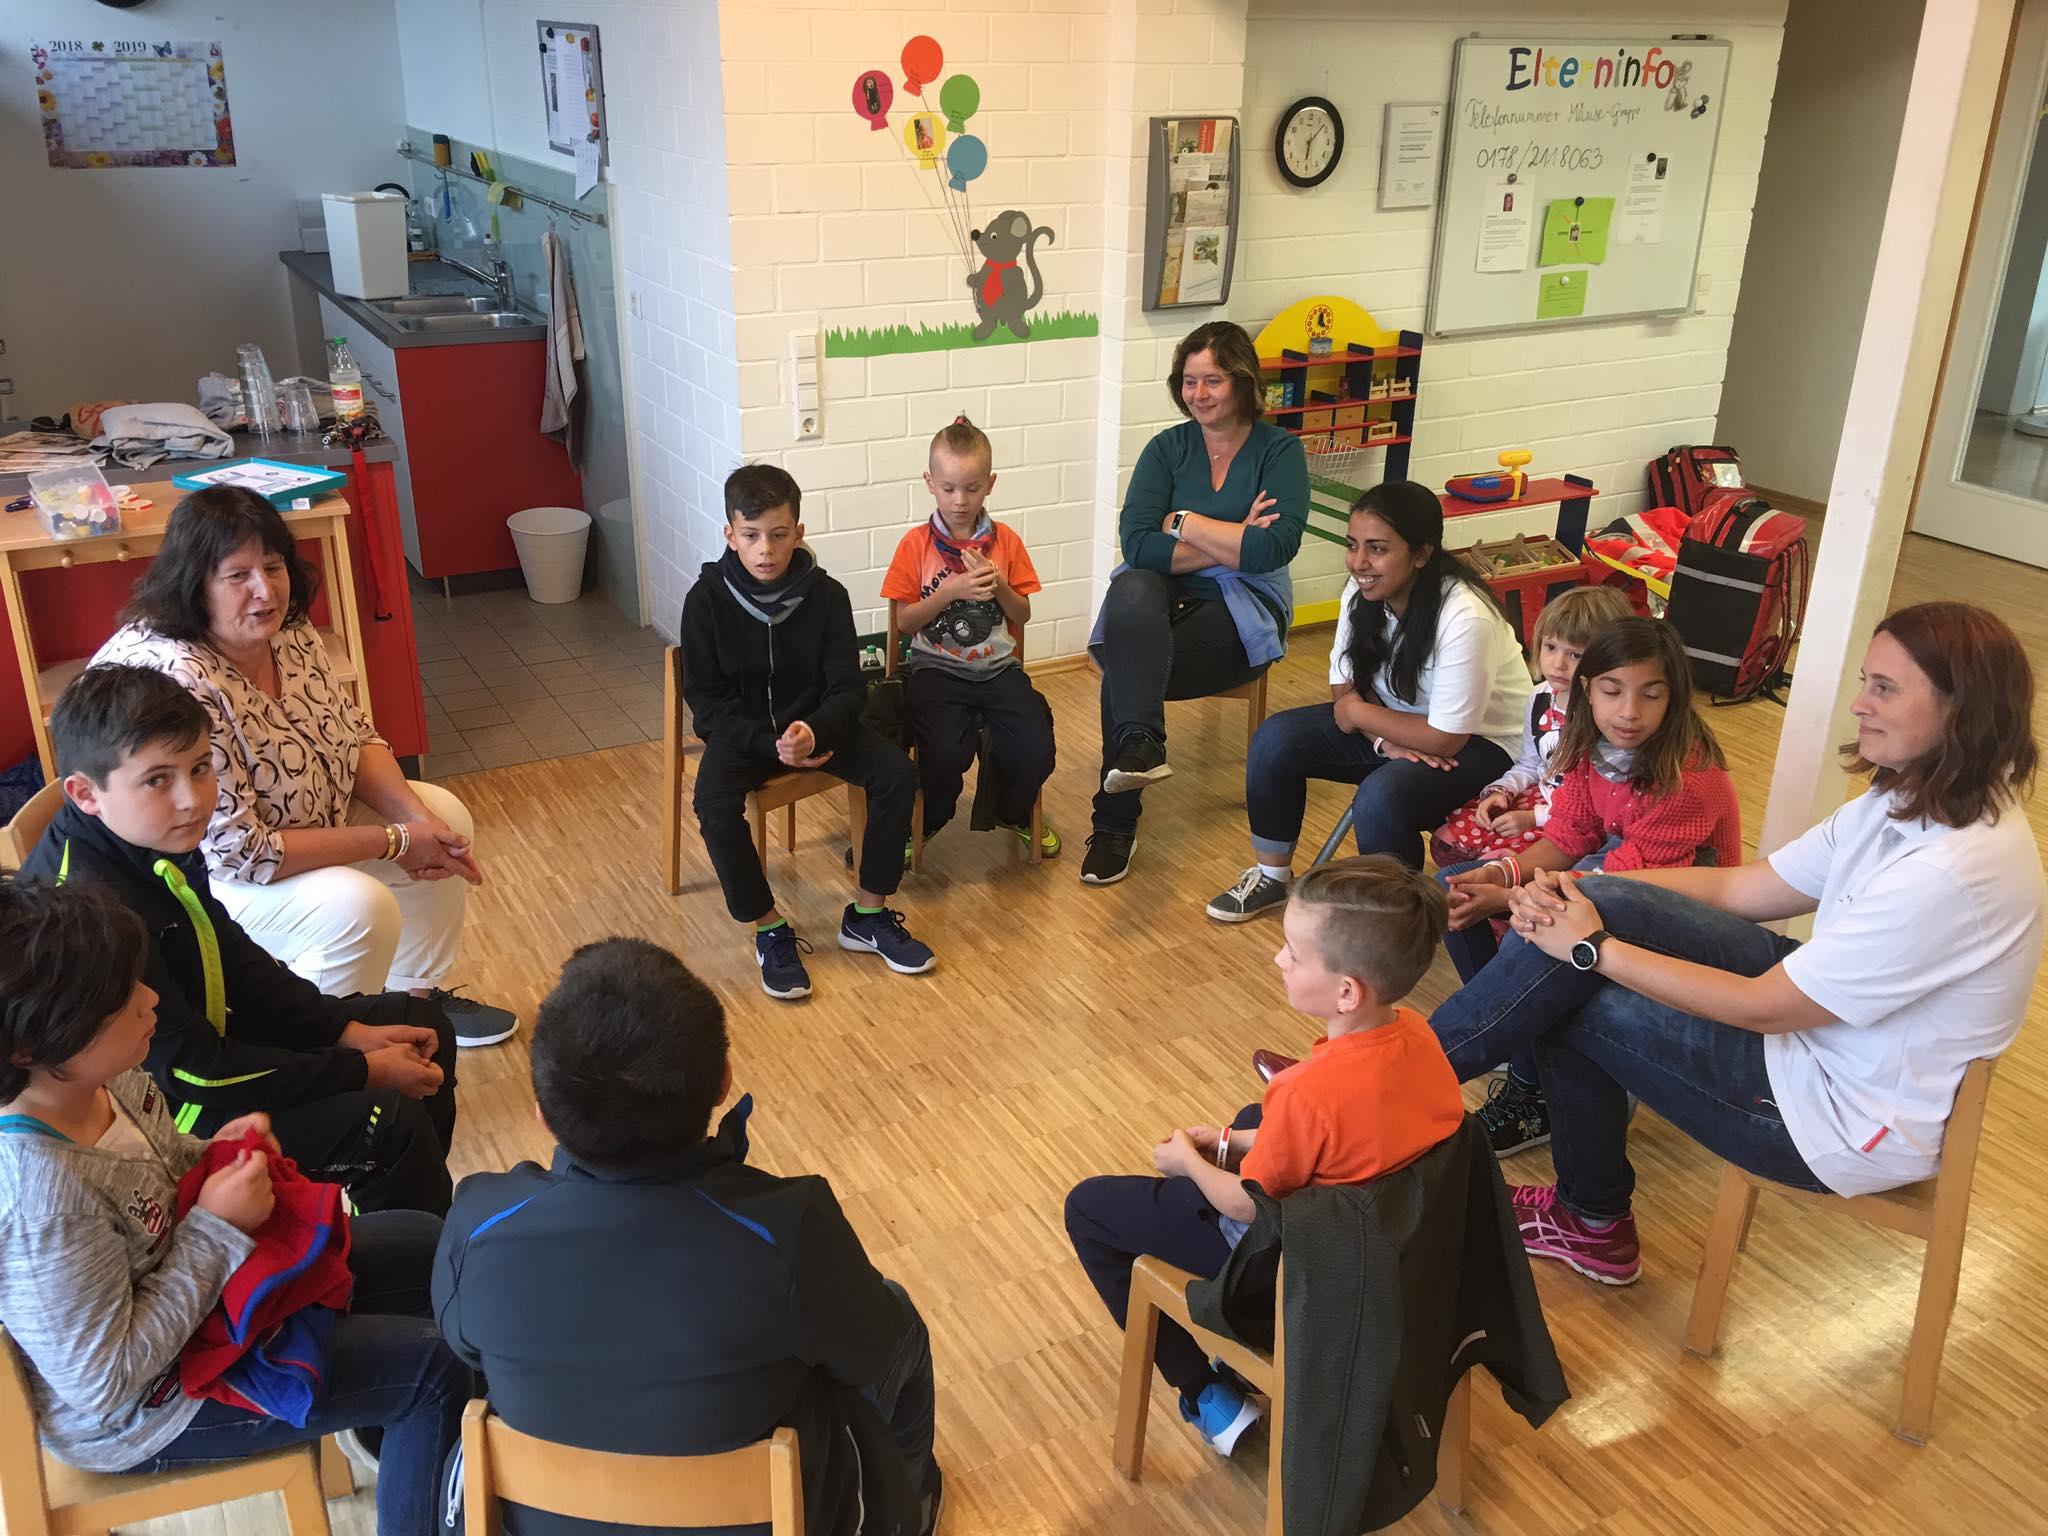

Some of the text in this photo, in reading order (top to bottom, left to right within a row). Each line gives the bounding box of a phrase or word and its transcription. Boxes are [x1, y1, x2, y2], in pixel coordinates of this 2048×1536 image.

[49, 40, 146, 53] 2018 2019
[1505, 47, 1675, 91] Elterninfo
[1476, 140, 1603, 174] 0178/2118063
